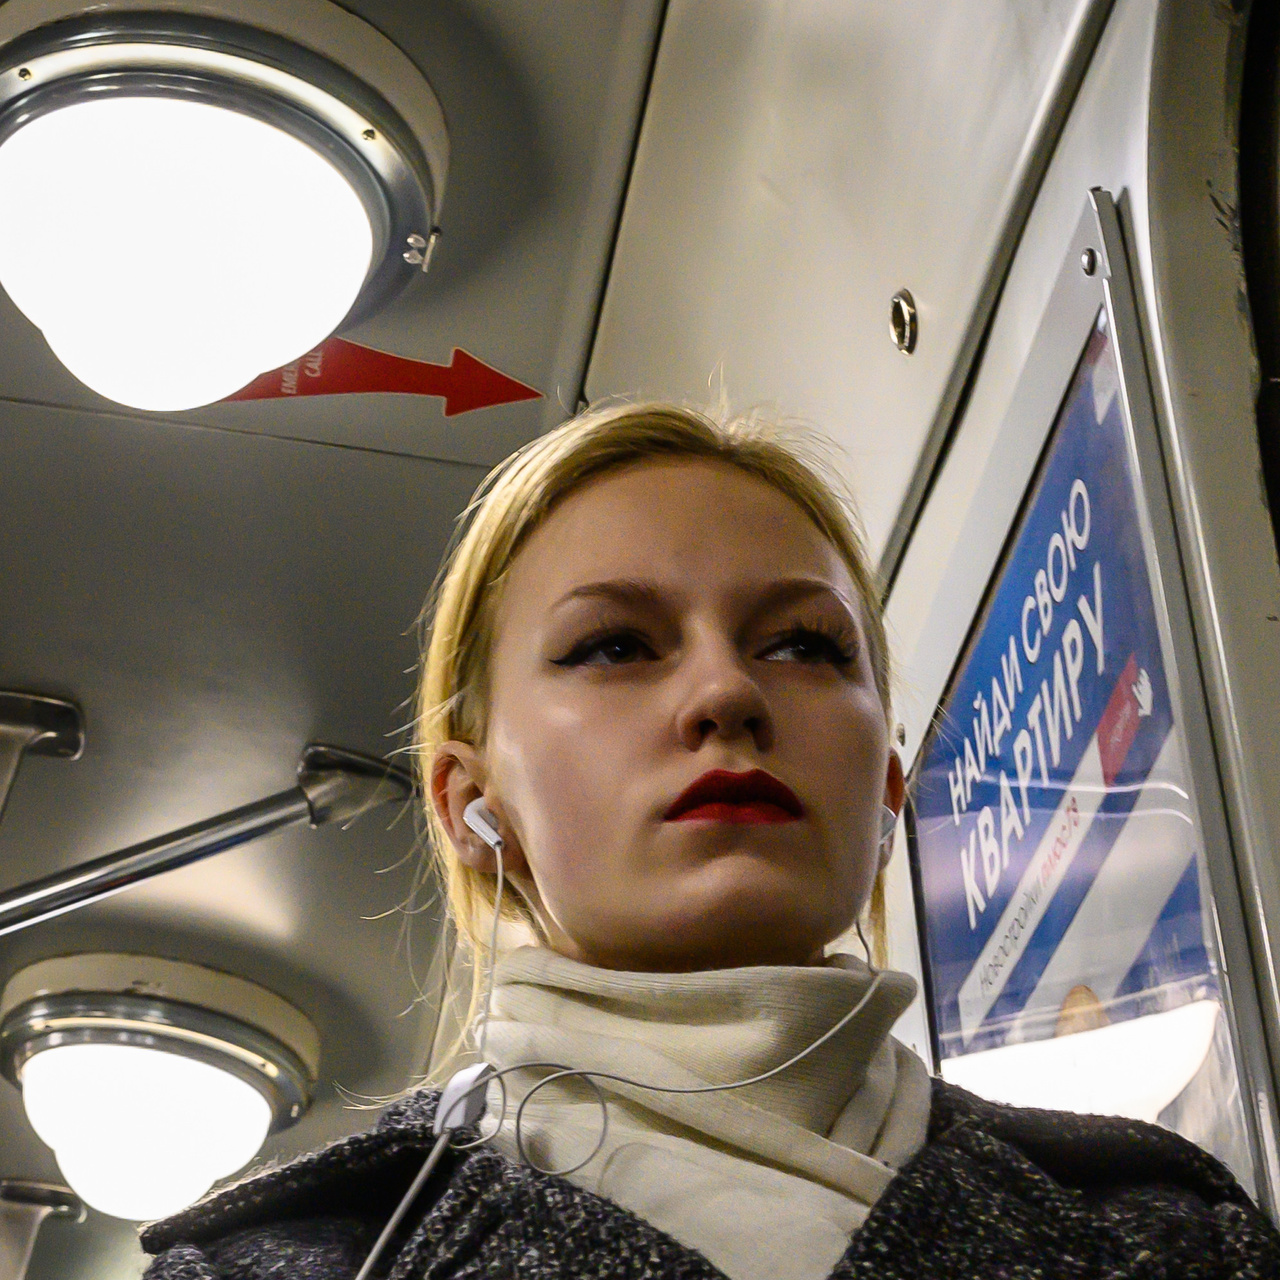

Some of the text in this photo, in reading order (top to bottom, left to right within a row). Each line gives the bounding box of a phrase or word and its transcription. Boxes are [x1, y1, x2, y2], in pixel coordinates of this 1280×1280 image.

[949, 478, 1091, 826] НАЙДИ СВОЮ
[961, 561, 1104, 931] КВАРТИРУ
